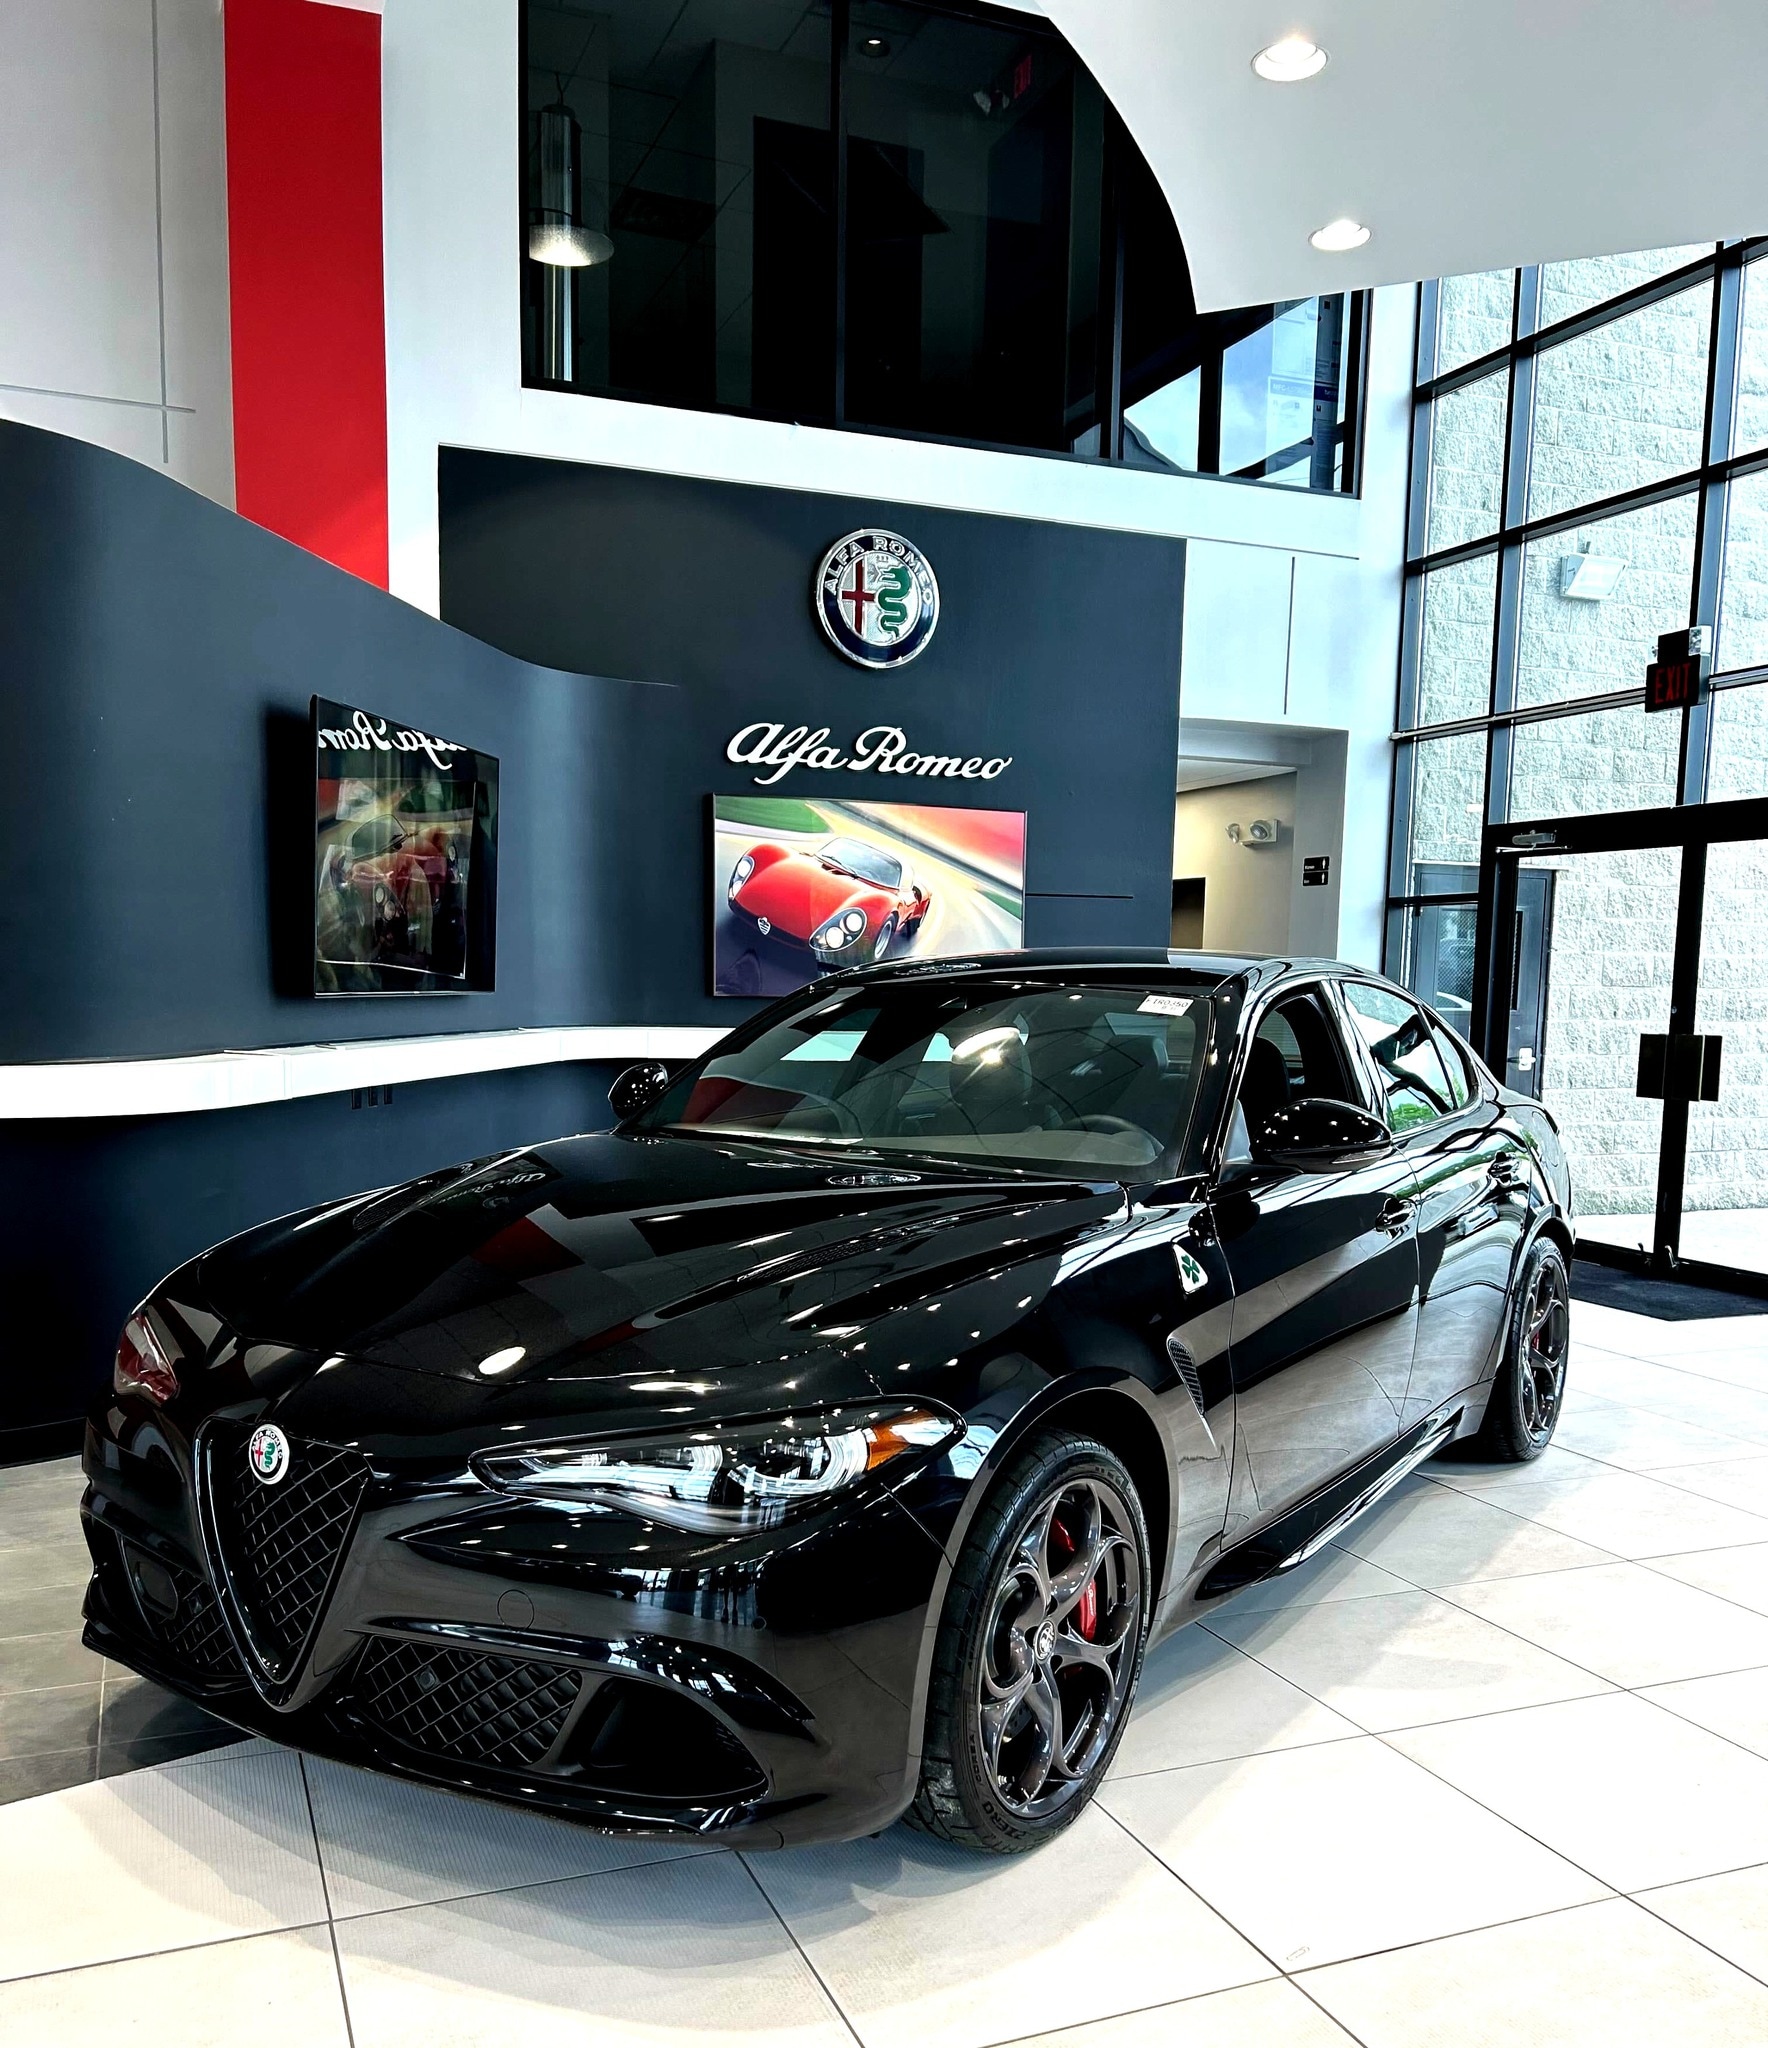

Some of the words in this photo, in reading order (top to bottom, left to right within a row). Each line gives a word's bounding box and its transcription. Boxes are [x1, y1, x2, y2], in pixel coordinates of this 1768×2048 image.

[823, 540, 865, 597] ALFA
[872, 534, 934, 605] ROMEO
[1654, 662, 1691, 704] EXIT
[727, 722, 848, 785] Alfa
[848, 725, 1014, 780] Romeo
